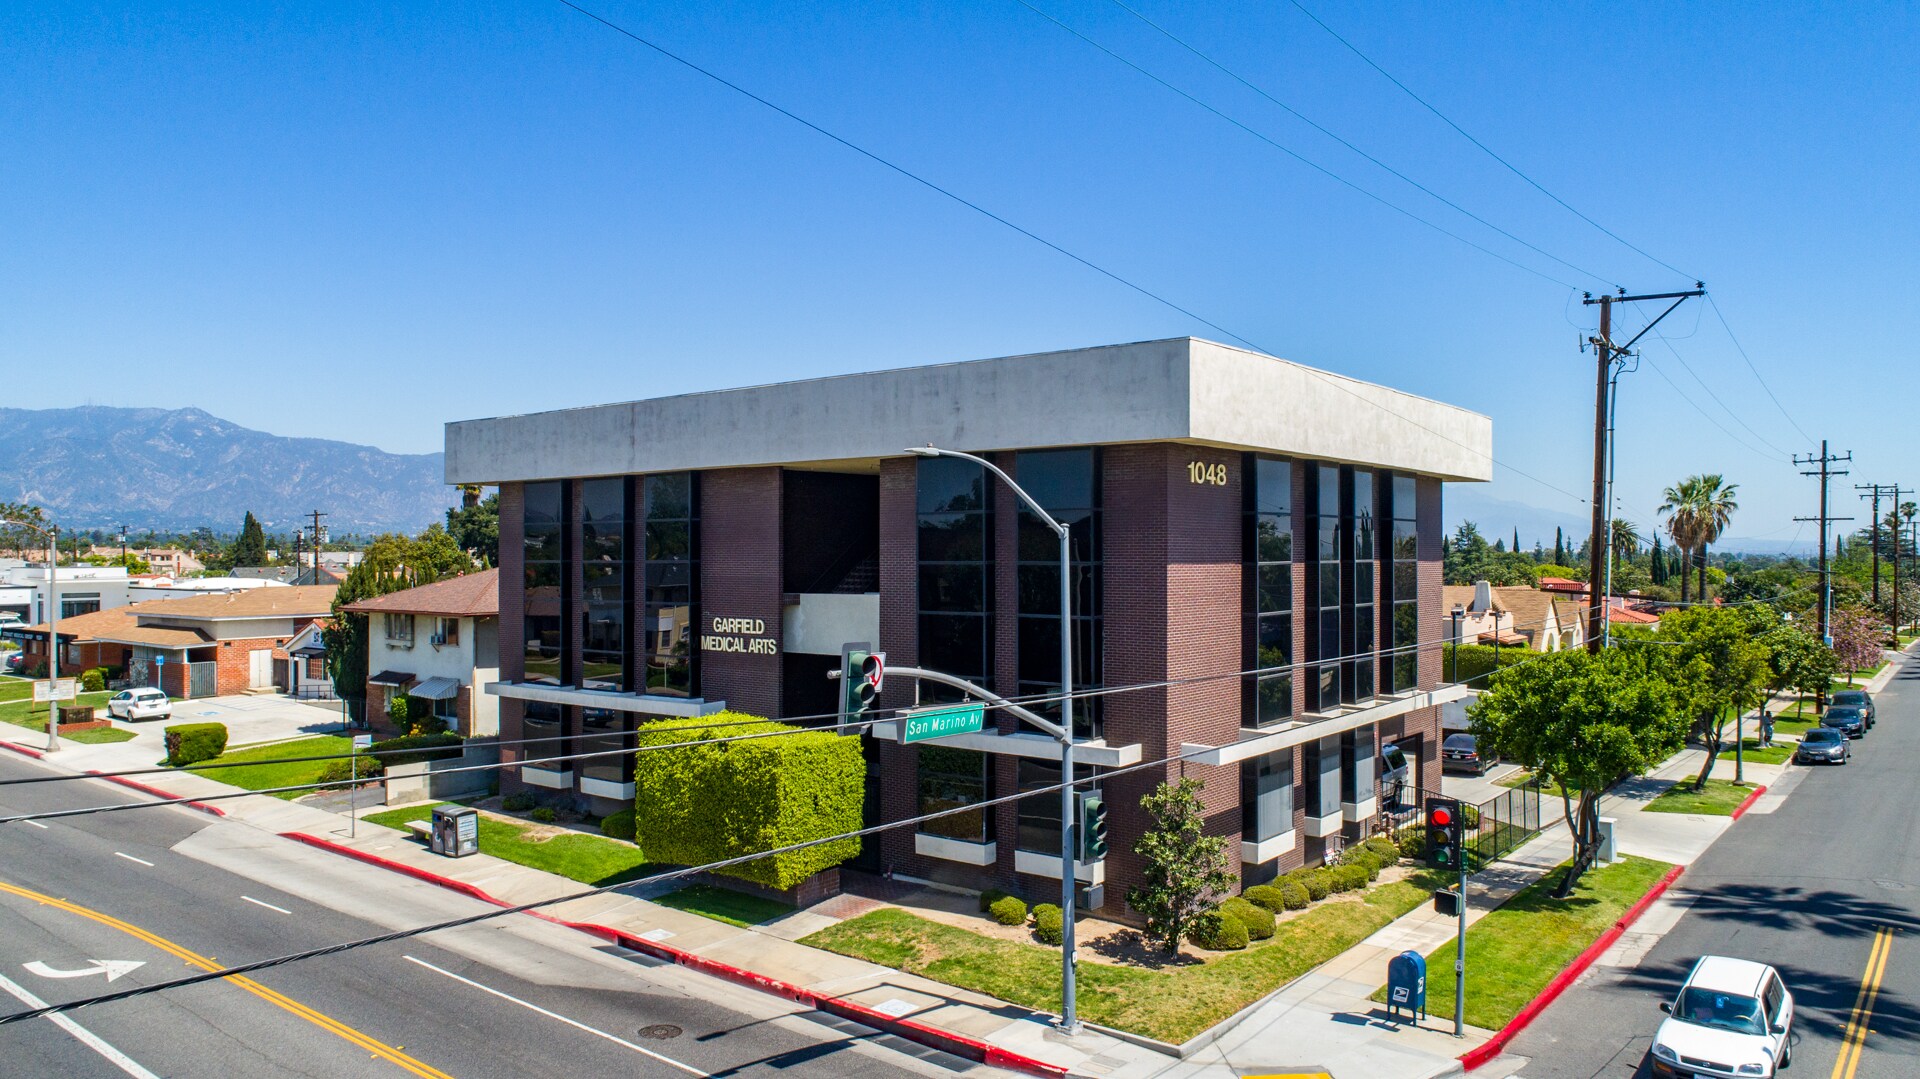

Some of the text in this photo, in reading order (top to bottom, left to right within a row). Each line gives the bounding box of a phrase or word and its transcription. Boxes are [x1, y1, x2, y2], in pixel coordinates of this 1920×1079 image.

[1187, 461, 1227, 486] 1048
[713, 617, 764, 634] GARFIELD
[701, 635, 777, 655] MEDICAL ARTS
[909, 712, 980, 735] San Marino Av
